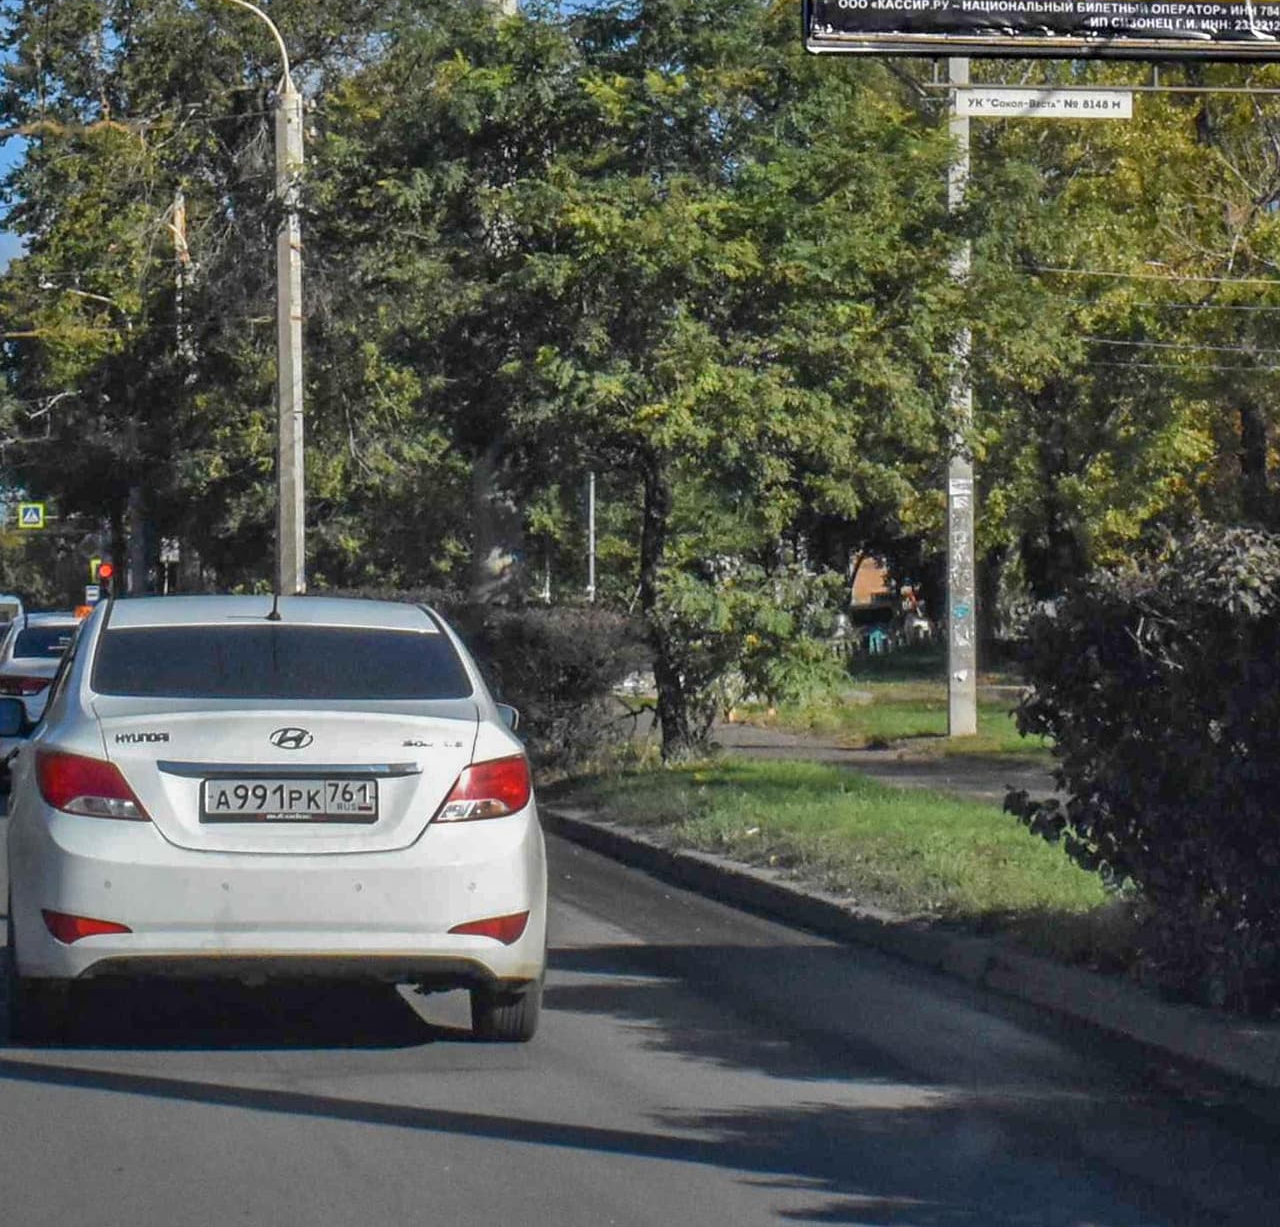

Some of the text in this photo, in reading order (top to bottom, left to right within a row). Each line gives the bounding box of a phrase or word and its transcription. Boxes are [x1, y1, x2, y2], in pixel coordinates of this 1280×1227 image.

[962, 1, 1073, 13] НАЦИОНАЛЬНЫЙ
[1077, 1, 1149, 14] БИЛЕТНЫЙ
[1151, 3, 1227, 15] ОПЕРАТОР»
[1230, 5, 1257, 16] ИНН
[1090, 17, 1108, 27] ИП
[968, 98, 983, 108] УК
[115, 732, 169, 743] HYUNDAI
